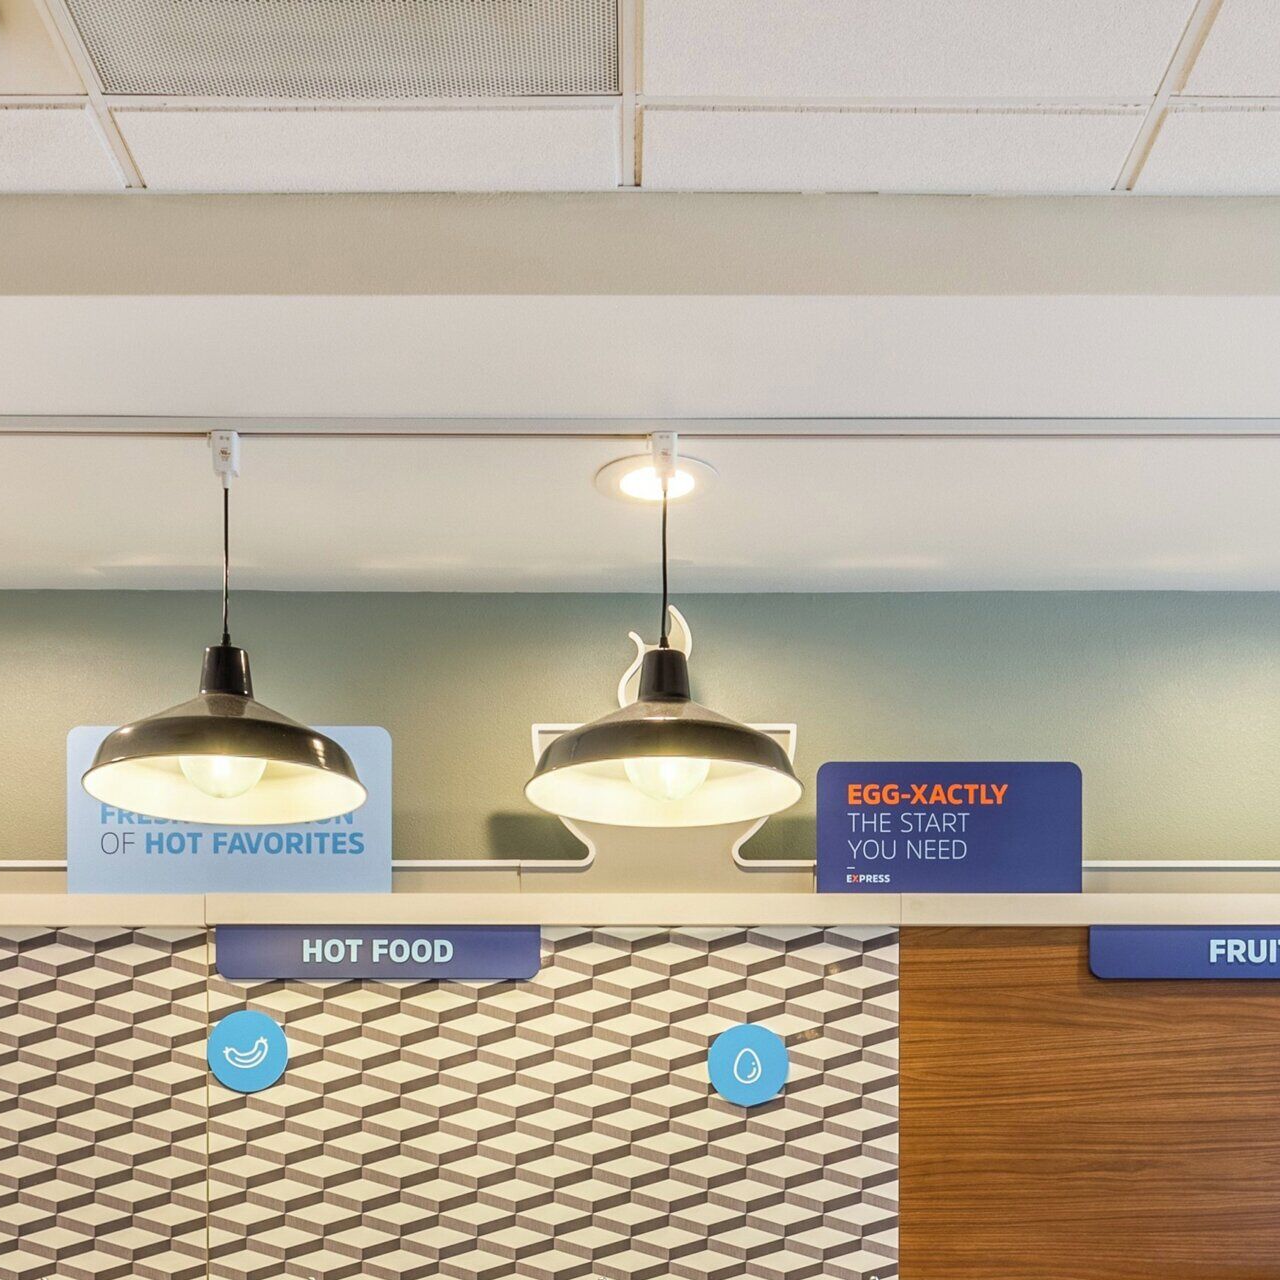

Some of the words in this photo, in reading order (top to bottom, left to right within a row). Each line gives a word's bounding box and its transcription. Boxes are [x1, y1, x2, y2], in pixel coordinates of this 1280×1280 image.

[847, 783, 1008, 805] EGG-XACTLY
[847, 812, 891, 833] THE
[900, 812, 970, 833] START
[101, 832, 135, 855] OF
[145, 832, 203, 855] HOT
[213, 832, 365, 855] FAVORITES
[847, 839, 896, 860] YOU
[906, 839, 968, 860] NEED
[846, 874, 890, 883] EXPRESS
[302, 938, 362, 963] HOT
[372, 938, 454, 963] FOOD
